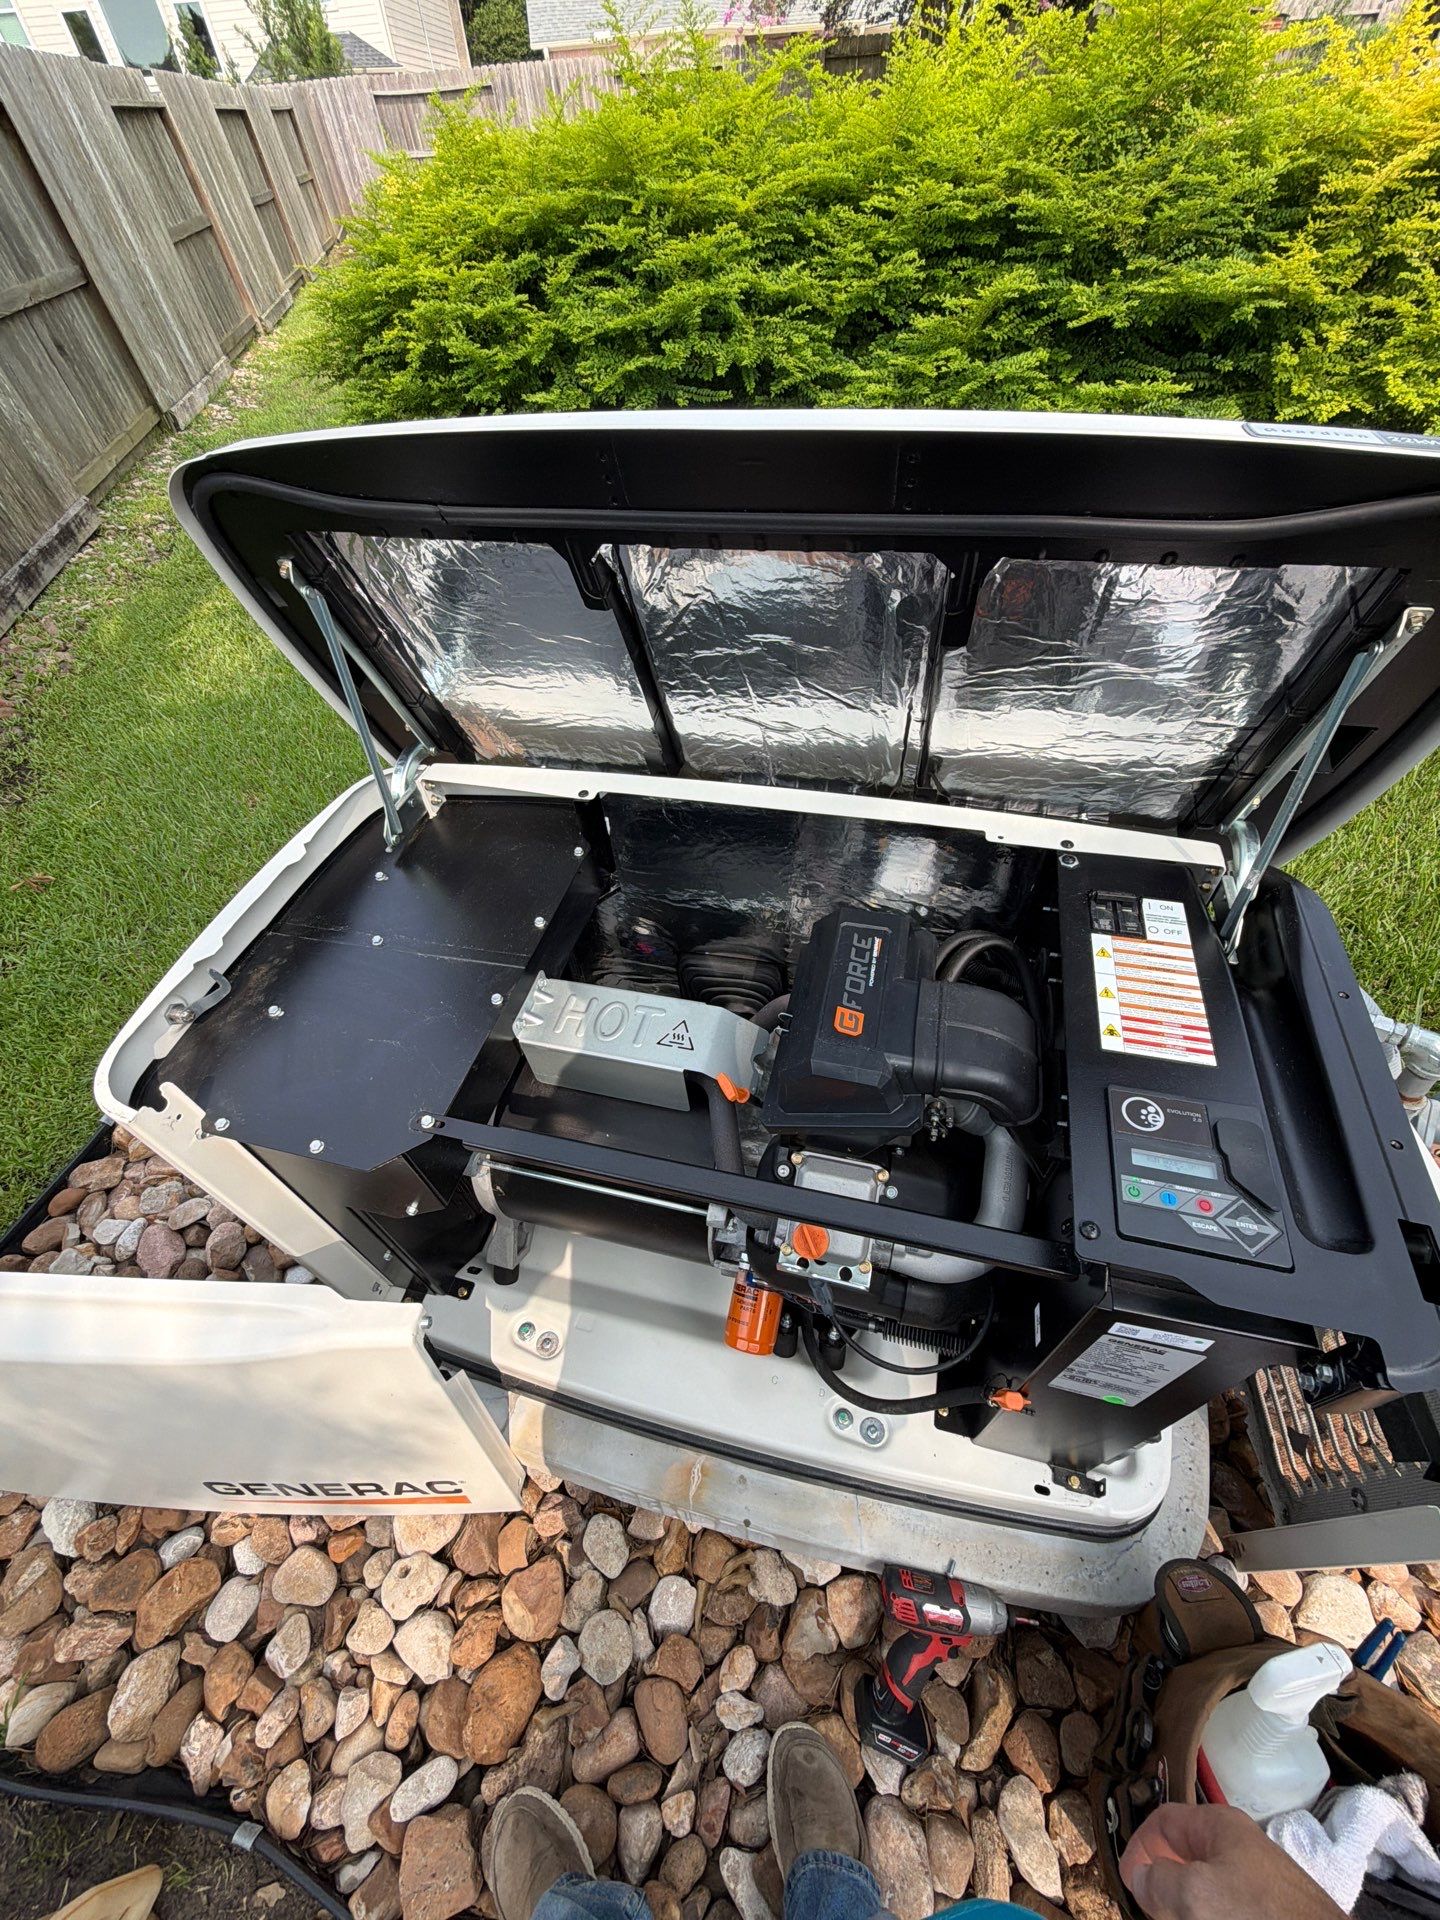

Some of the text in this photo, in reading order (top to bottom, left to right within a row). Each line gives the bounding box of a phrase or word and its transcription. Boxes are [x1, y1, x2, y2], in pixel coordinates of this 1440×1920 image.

[1263, 427, 1369, 439] Guardian
[1163, 928, 1183, 936] OFF
[553, 993, 666, 1048] HOT
[1166, 1108, 1202, 1118] EVOLUTION
[1191, 1221, 1259, 1232] ESCAPE ENTER
[734, 1283, 760, 1297] ERAC
[1108, 1338, 1168, 1355] GENERAC
[202, 1480, 464, 1497] GENERAC
